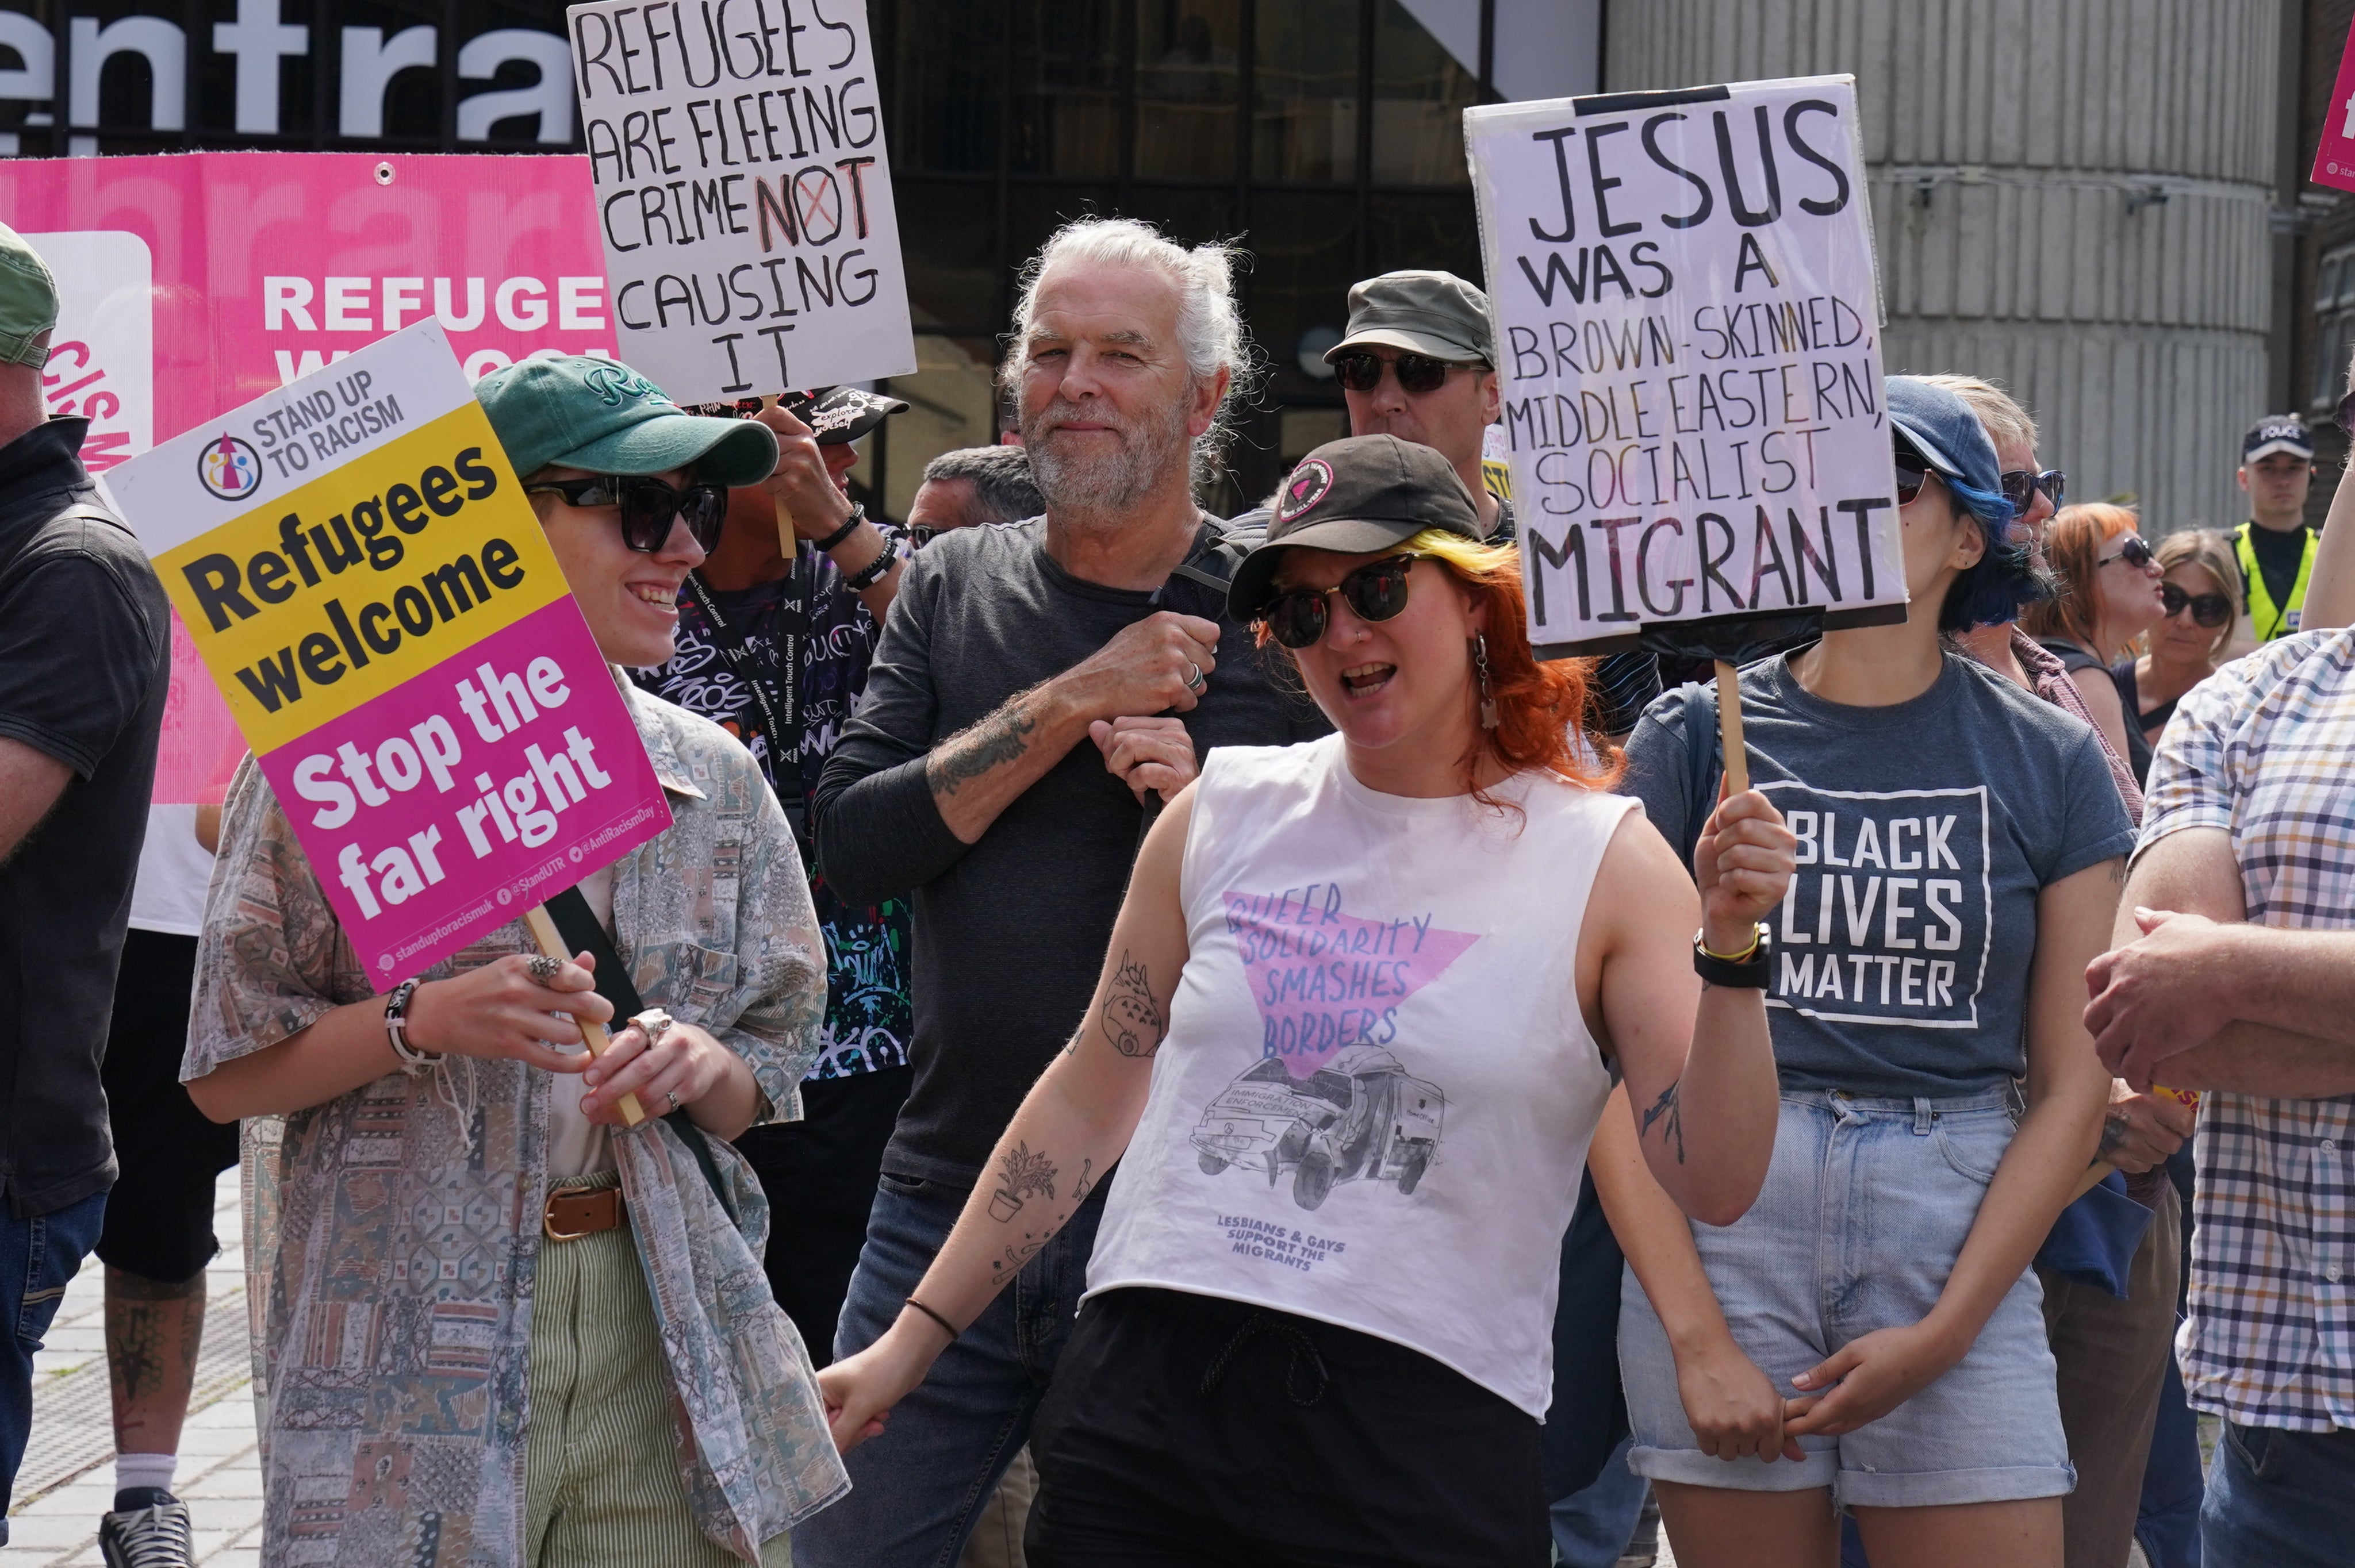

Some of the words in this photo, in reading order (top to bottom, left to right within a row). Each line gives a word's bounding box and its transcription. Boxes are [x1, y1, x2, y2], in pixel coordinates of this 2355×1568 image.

[575, 0, 856, 98] REFUGEES
[586, 107, 681, 184] ARE
[687, 76, 877, 168] FLEEING
[1529, 99, 1850, 242] JESUS
[604, 173, 749, 252] CRIME
[754, 156, 876, 253] NOT
[617, 249, 878, 330] CAUSING
[1517, 241, 1674, 307] WAS
[1733, 232, 1779, 292] A
[263, 276, 605, 332] REFUGE
[712, 324, 795, 393] IT
[1508, 296, 1873, 380] BROWN-SKINNED,
[253, 389, 336, 448] STAND
[335, 370, 373, 408] UP
[267, 440, 310, 479] TO
[309, 393, 405, 460] RACISM
[821, 408, 858, 422] explore
[1506, 381, 1660, 452] MIDDLE
[1669, 358, 1884, 434] EASTERN,
[2260, 425, 2300, 441] POLICE
[1535, 427, 1832, 514] SOCIALIST
[181, 445, 498, 633] Refugees
[1529, 498, 1891, 627] MIGRANT
[234, 537, 526, 714] welcome
[696, 583, 711, 604] Touch
[707, 601, 727, 628] Control
[785, 634, 794, 662] Control
[785, 662, 794, 685] Touch
[751, 679, 771, 716] Intelligent
[785, 685, 794, 724] Intelligent
[292, 715, 463, 830] Stop
[454, 656, 572, 745] the
[337, 825, 446, 920] far
[455, 725, 612, 860] right
[1786, 810, 1961, 870] BLACK
[395, 898, 494, 962] standuptoracismuk
[511, 857, 566, 896] @StandUTR
[581, 805, 655, 854] @AntiRacismDay
[1225, 882, 1342, 935] QUEER
[1781, 874, 1963, 951] LIVES
[1242, 912, 1432, 965] SOLIDARITY
[1263, 960, 1410, 1006] SMASHES
[1779, 951, 1957, 1006] MATTER
[1263, 1006, 1399, 1059] BORDERS
[1225, 1097, 1310, 1120] ENFORCEMENT
[1230, 1089, 1311, 1110] IMMIGRATION
[1217, 1214, 1287, 1239] LESBIANS
[1290, 1230, 1302, 1243] &
[1307, 1234, 1346, 1254] GAYS
[1227, 1228, 1298, 1254] SUPPORT
[1299, 1246, 1326, 1262] THE
[1232, 1241, 1311, 1272] MIGRANTS
